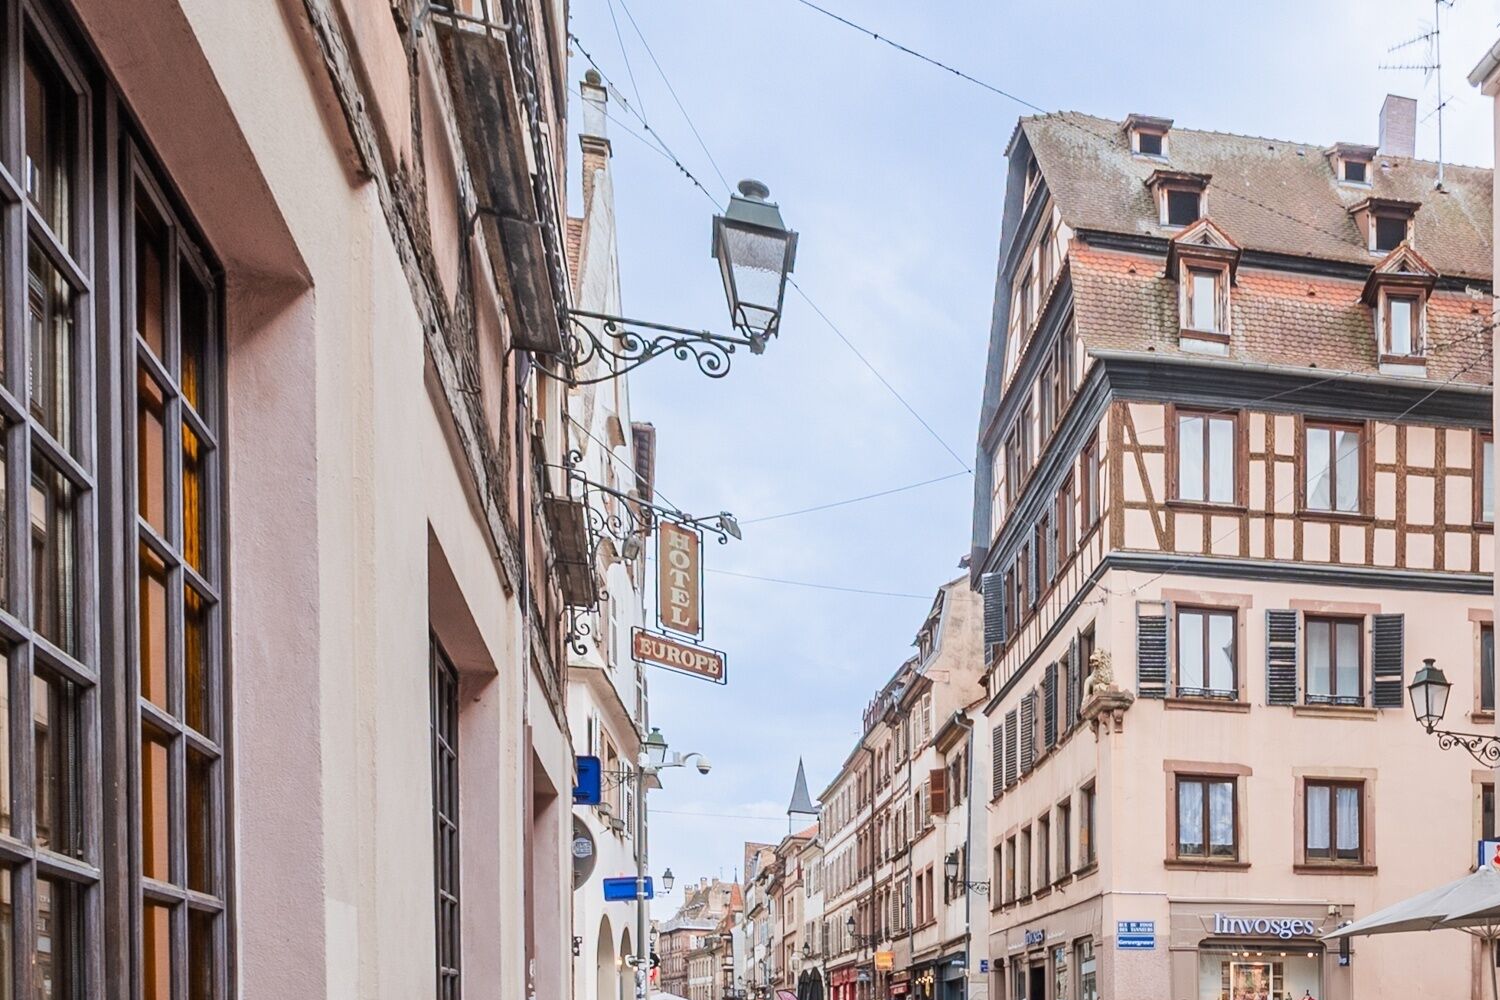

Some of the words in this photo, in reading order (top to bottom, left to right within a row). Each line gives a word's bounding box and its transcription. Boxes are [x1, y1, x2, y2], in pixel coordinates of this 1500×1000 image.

[668, 529, 690, 627] HOTEL
[639, 637, 720, 675] EUROPE
[1214, 912, 1315, 939] linvosges
